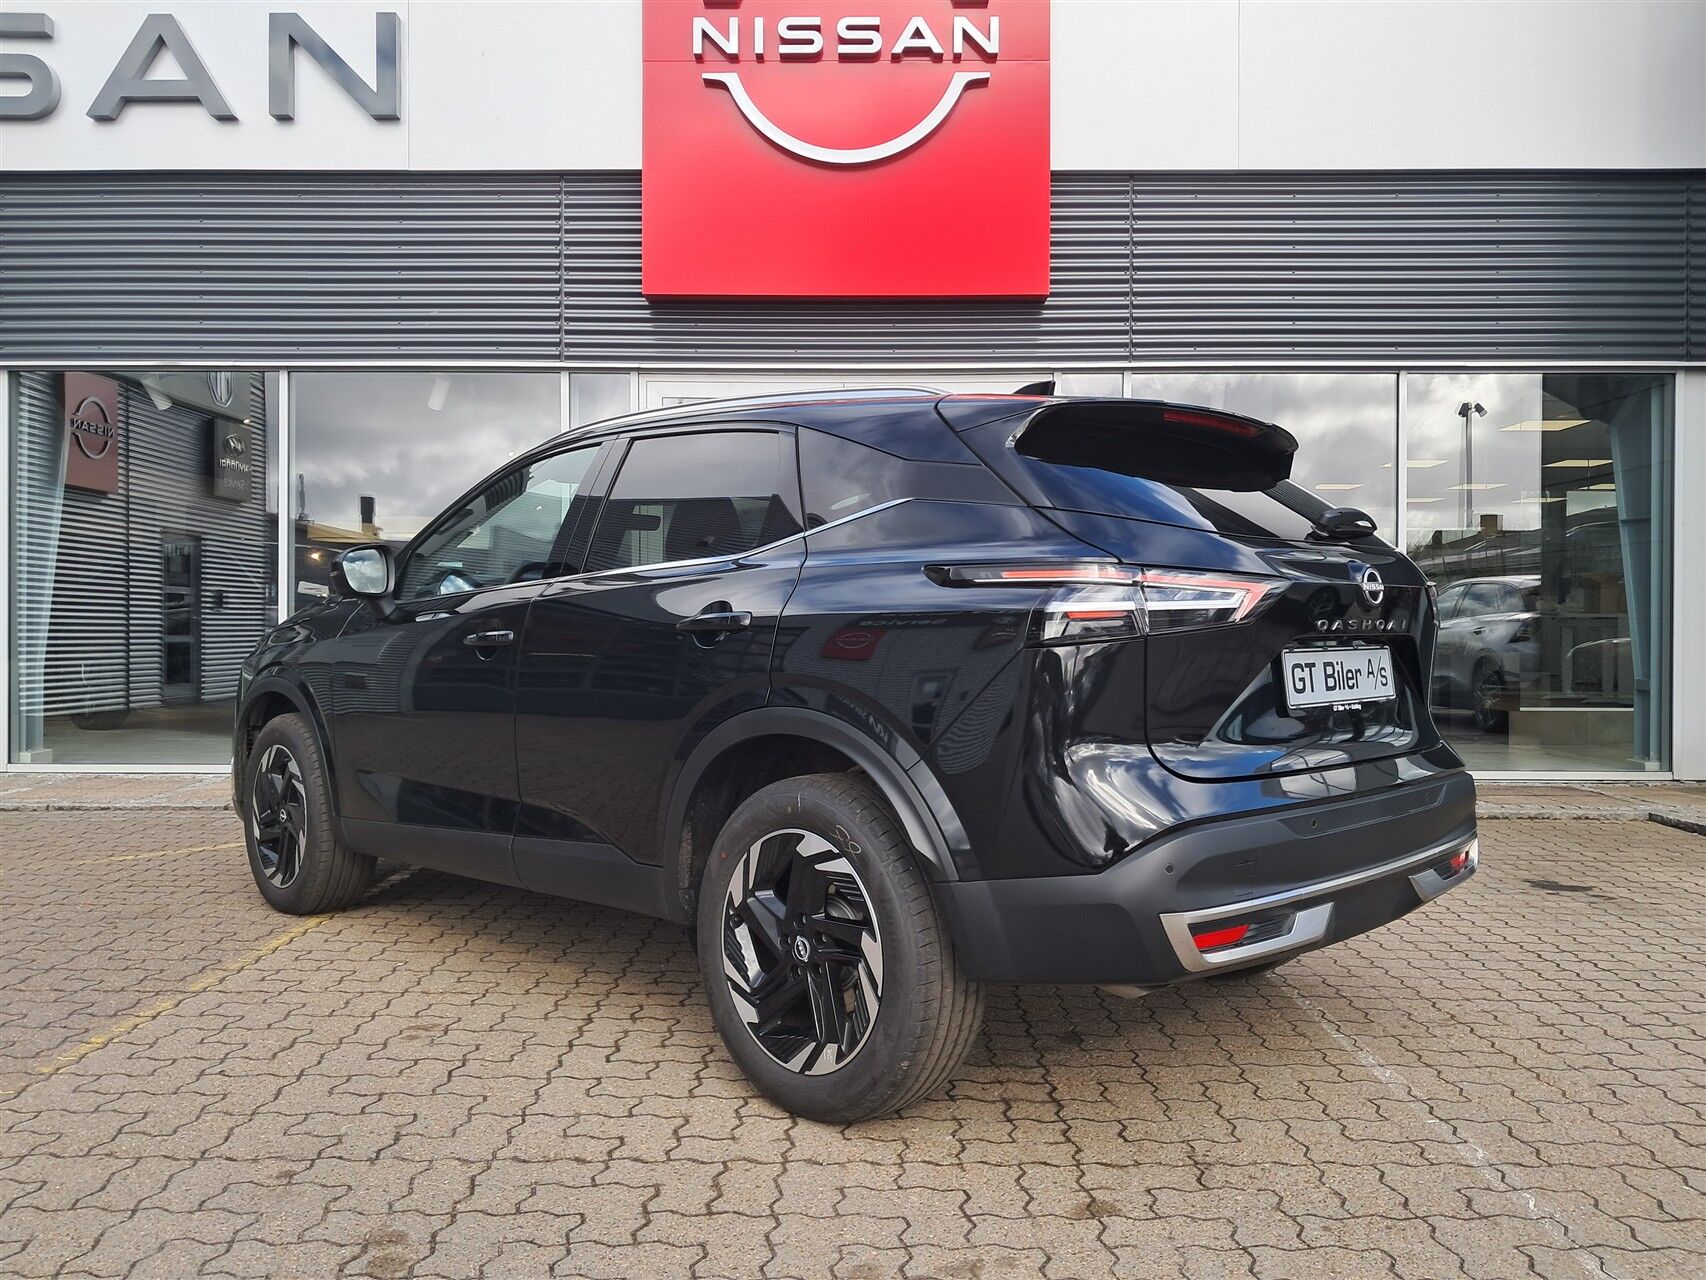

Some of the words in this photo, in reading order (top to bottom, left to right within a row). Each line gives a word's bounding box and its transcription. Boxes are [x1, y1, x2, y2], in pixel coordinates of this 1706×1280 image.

[692, 15, 1000, 61] NISSAN
[1316, 619, 1407, 633] QASHQAI
[1290, 662, 1316, 694] GT
[1322, 660, 1362, 692] Biler
